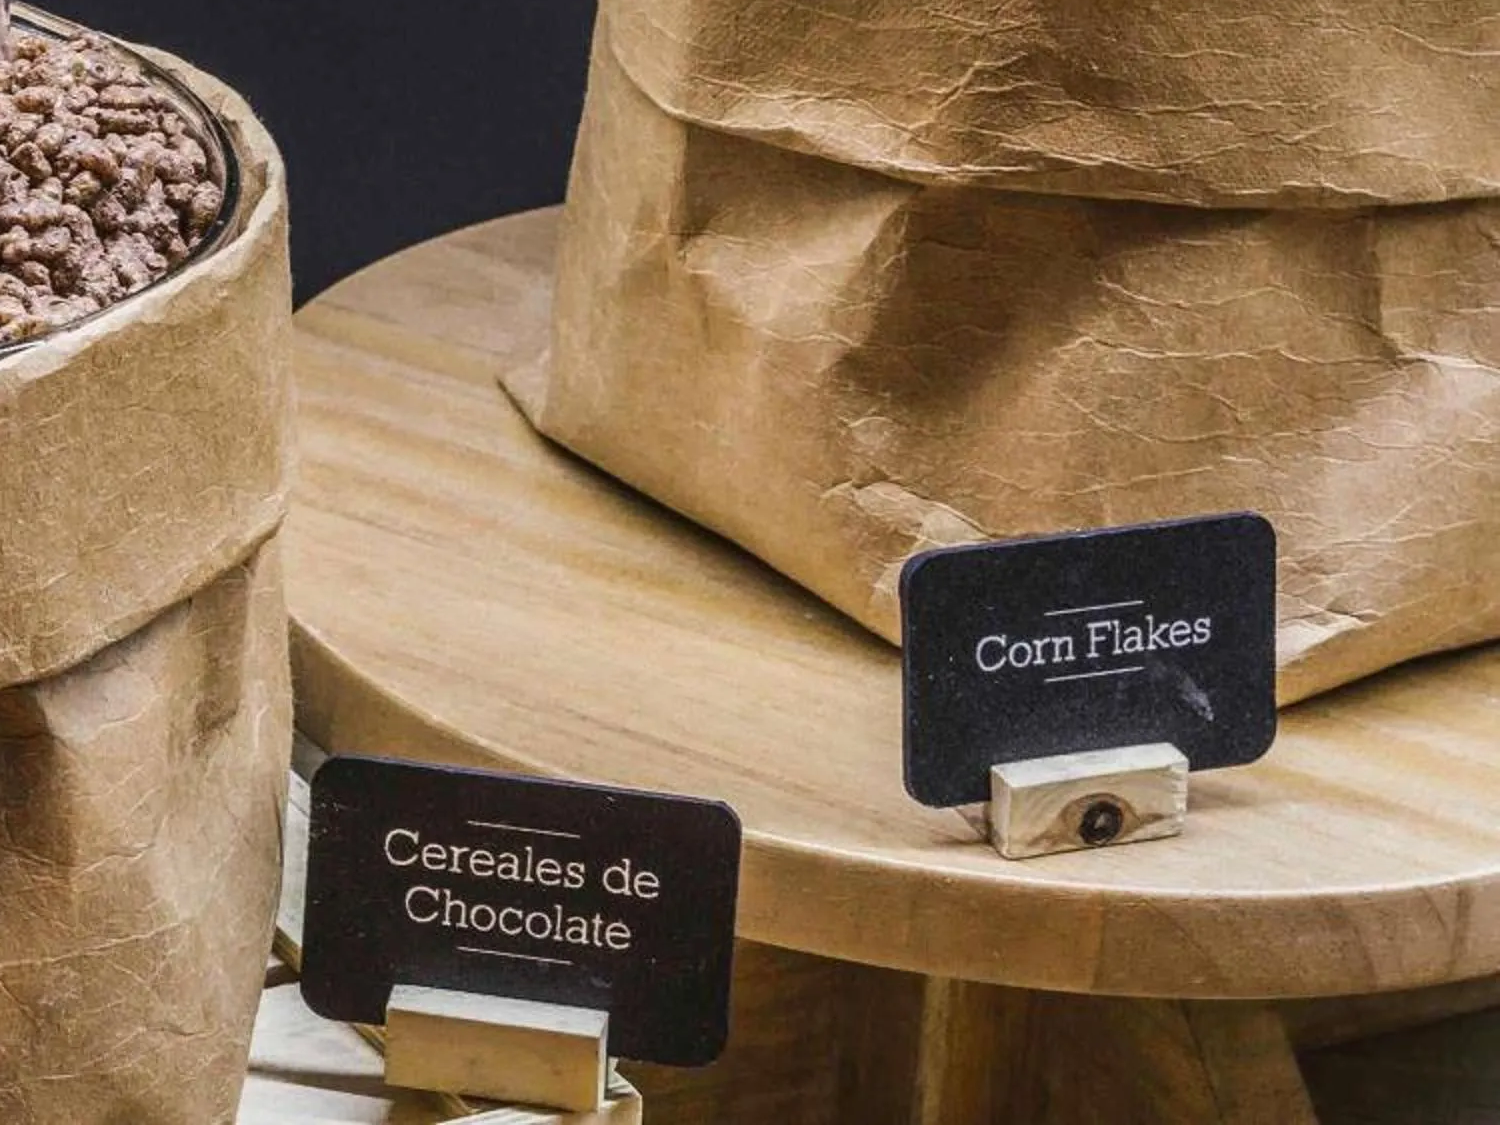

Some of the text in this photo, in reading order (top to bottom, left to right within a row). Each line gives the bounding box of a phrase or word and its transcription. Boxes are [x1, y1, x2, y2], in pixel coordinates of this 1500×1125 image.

[975, 614, 1212, 673] Corn Flakes
[383, 828, 662, 900] Cereales de
[404, 885, 632, 950] Chocolate
